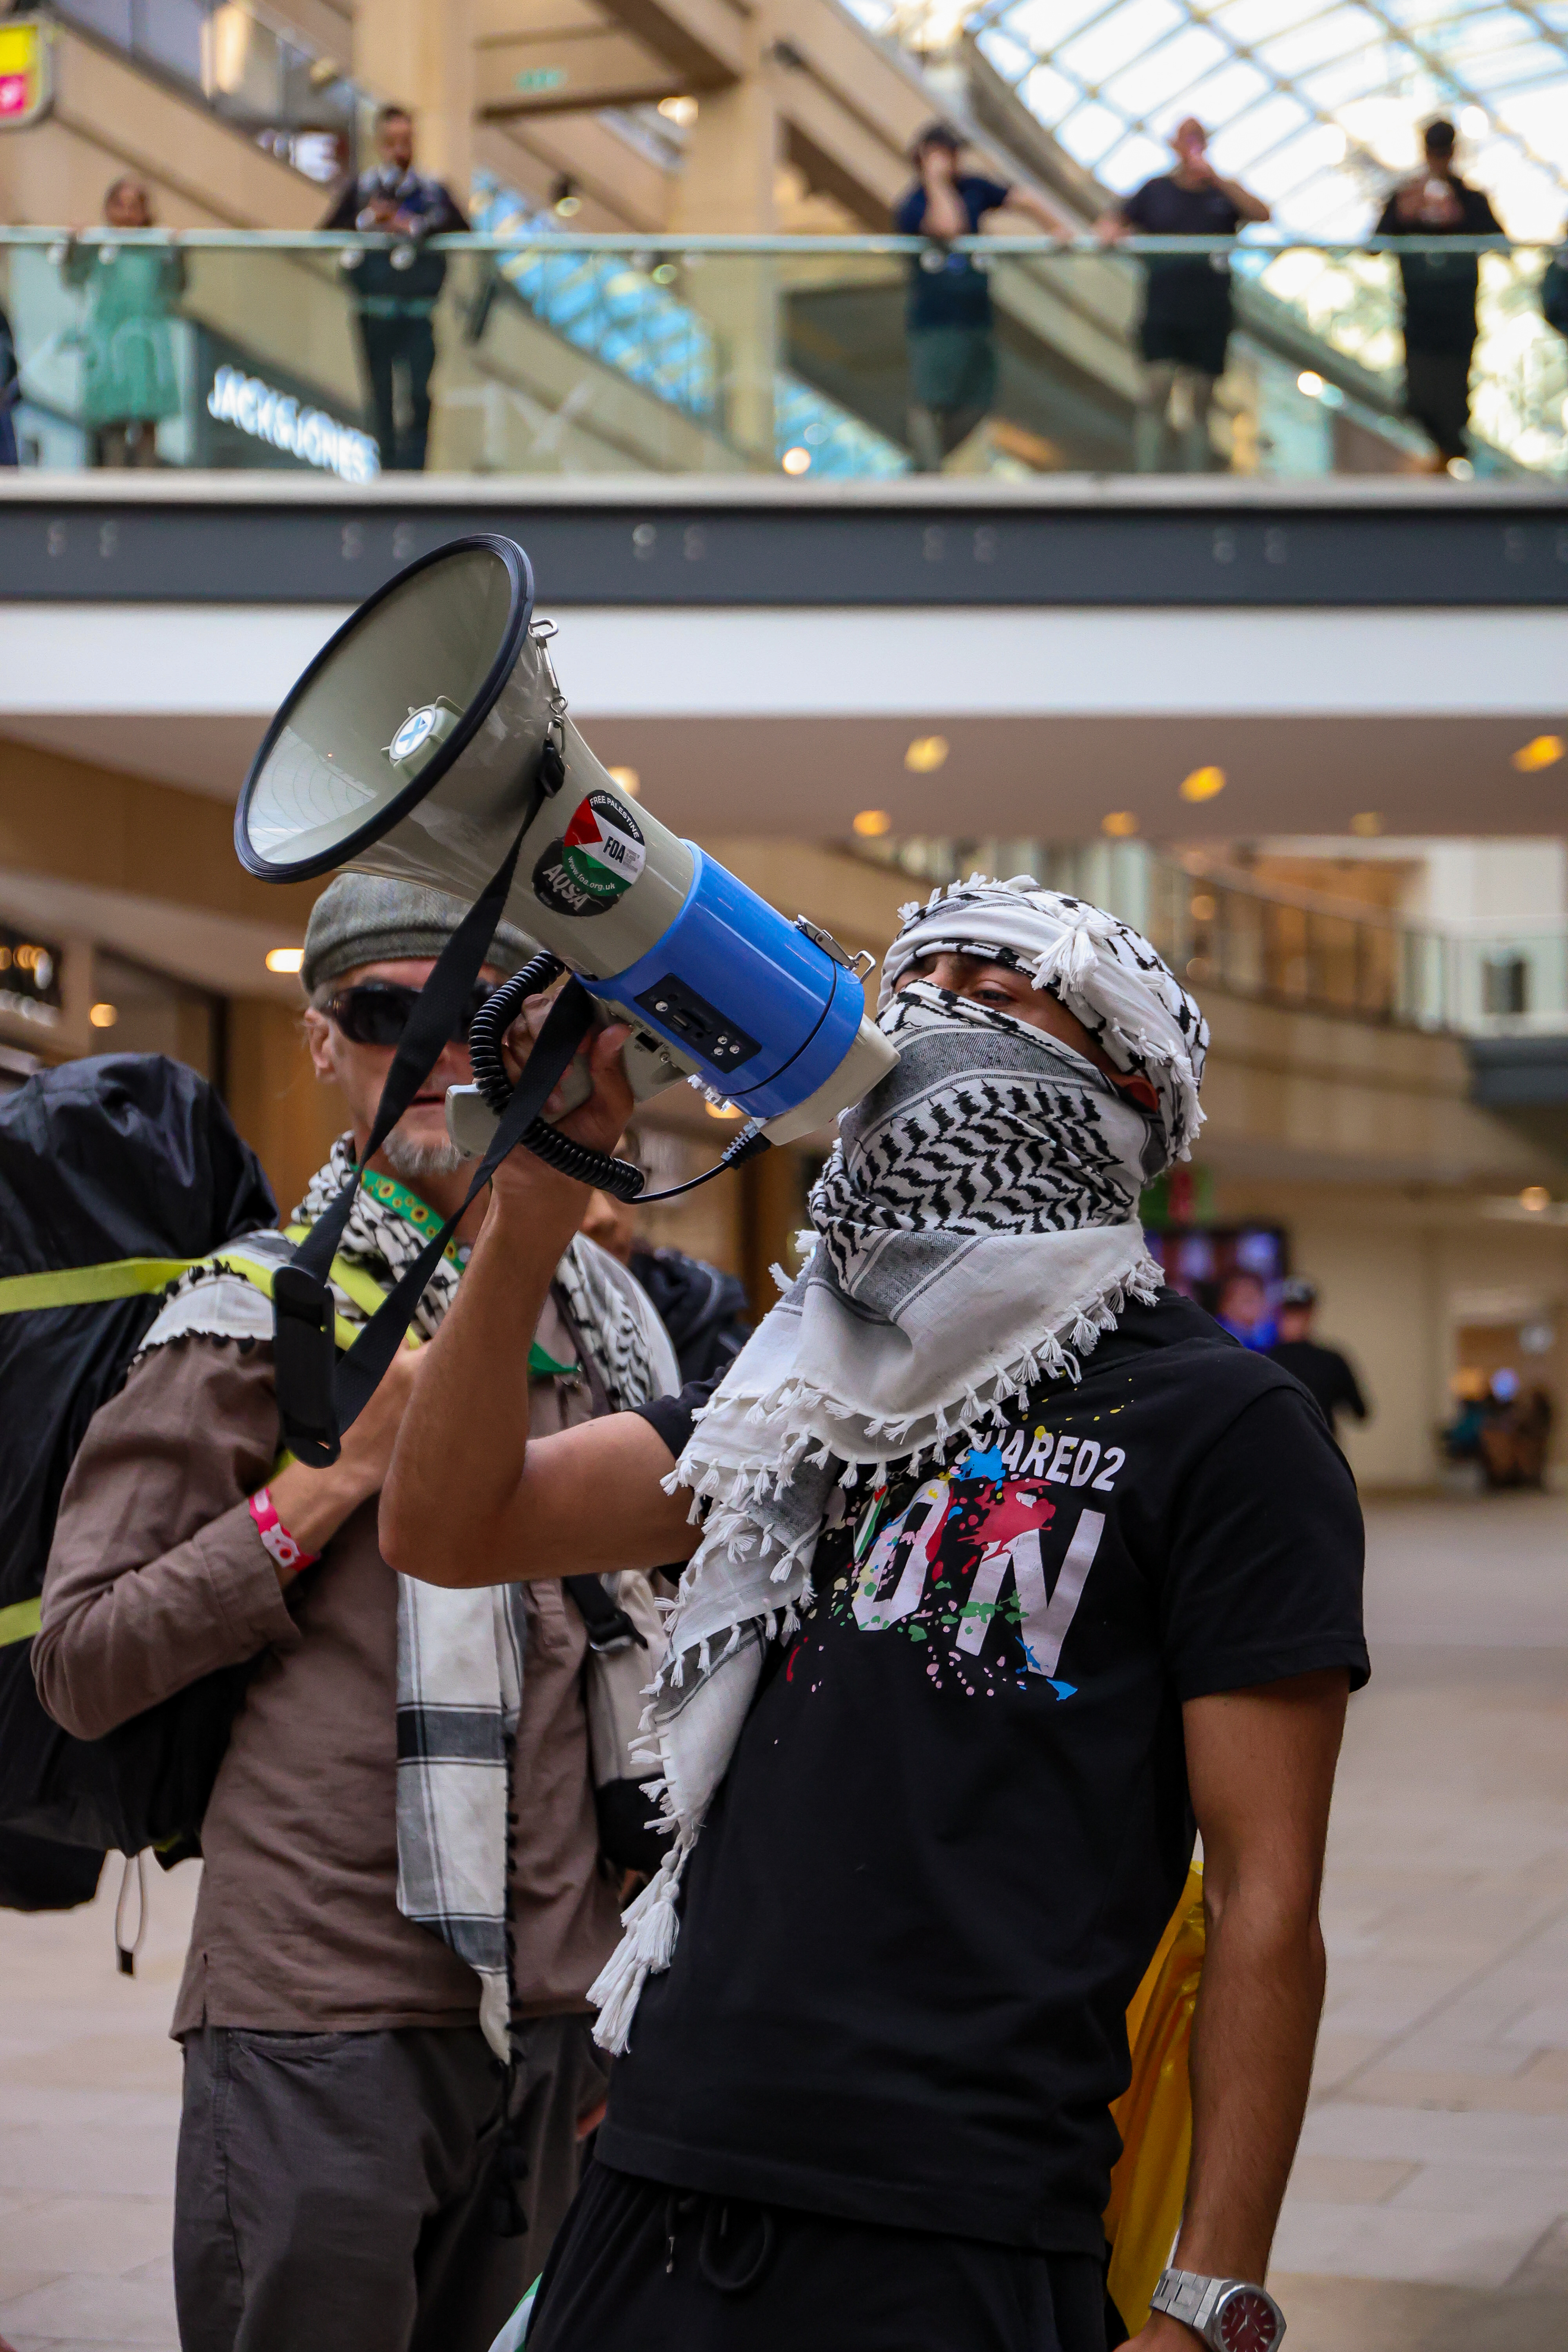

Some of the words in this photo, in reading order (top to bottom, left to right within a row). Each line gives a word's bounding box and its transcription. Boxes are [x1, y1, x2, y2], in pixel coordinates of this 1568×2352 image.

[590, 796, 606, 807] FREE
[607, 797, 639, 838] PALESTINE
[603, 836, 626, 864] FOA
[542, 864, 589, 911] AQSA
[568, 856, 615, 891] www.foa.org.uk
